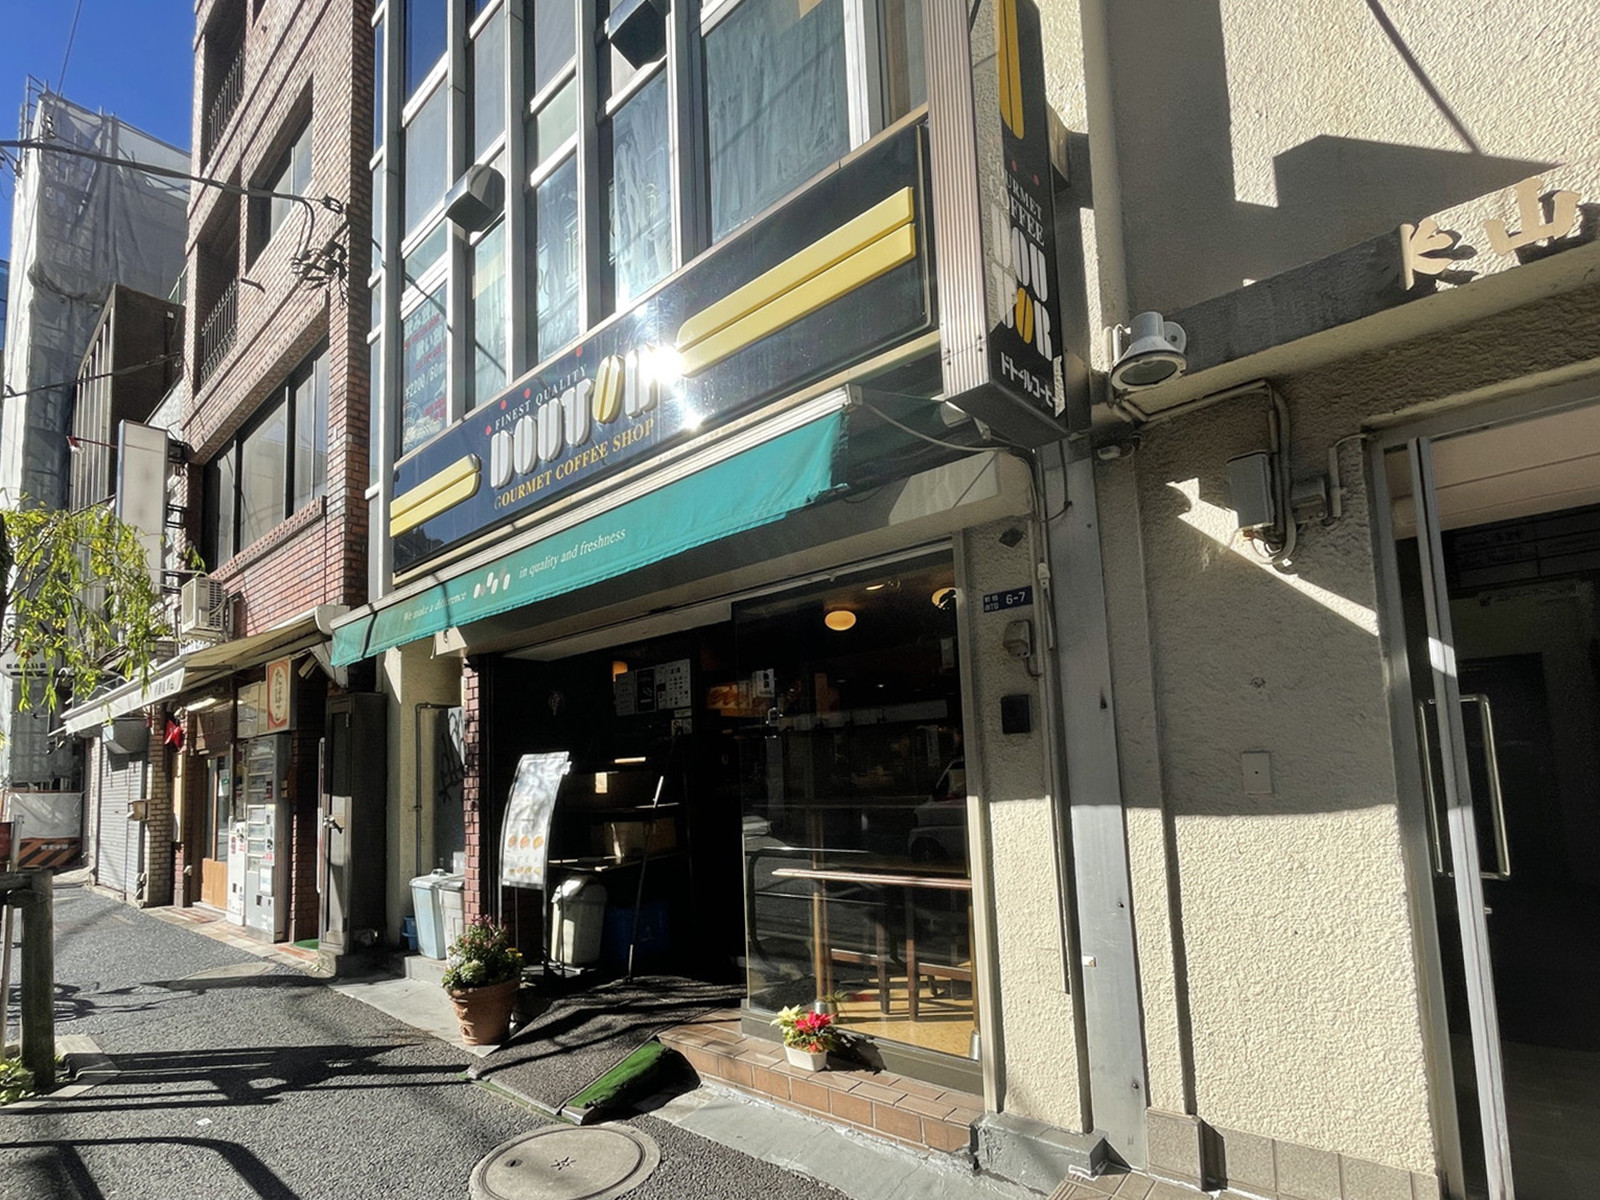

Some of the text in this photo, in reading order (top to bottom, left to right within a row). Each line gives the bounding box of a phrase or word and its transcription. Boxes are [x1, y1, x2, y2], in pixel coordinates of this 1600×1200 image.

[494, 363, 588, 431] FINEST QUALITY
[494, 418, 654, 510] GOURMET COFFEE SHOP
[519, 566, 528, 579] in
[529, 555, 559, 578] quality
[560, 544, 579, 563] and
[579, 528, 627, 556] freshness
[1005, 591, 1026, 605] 6-7
